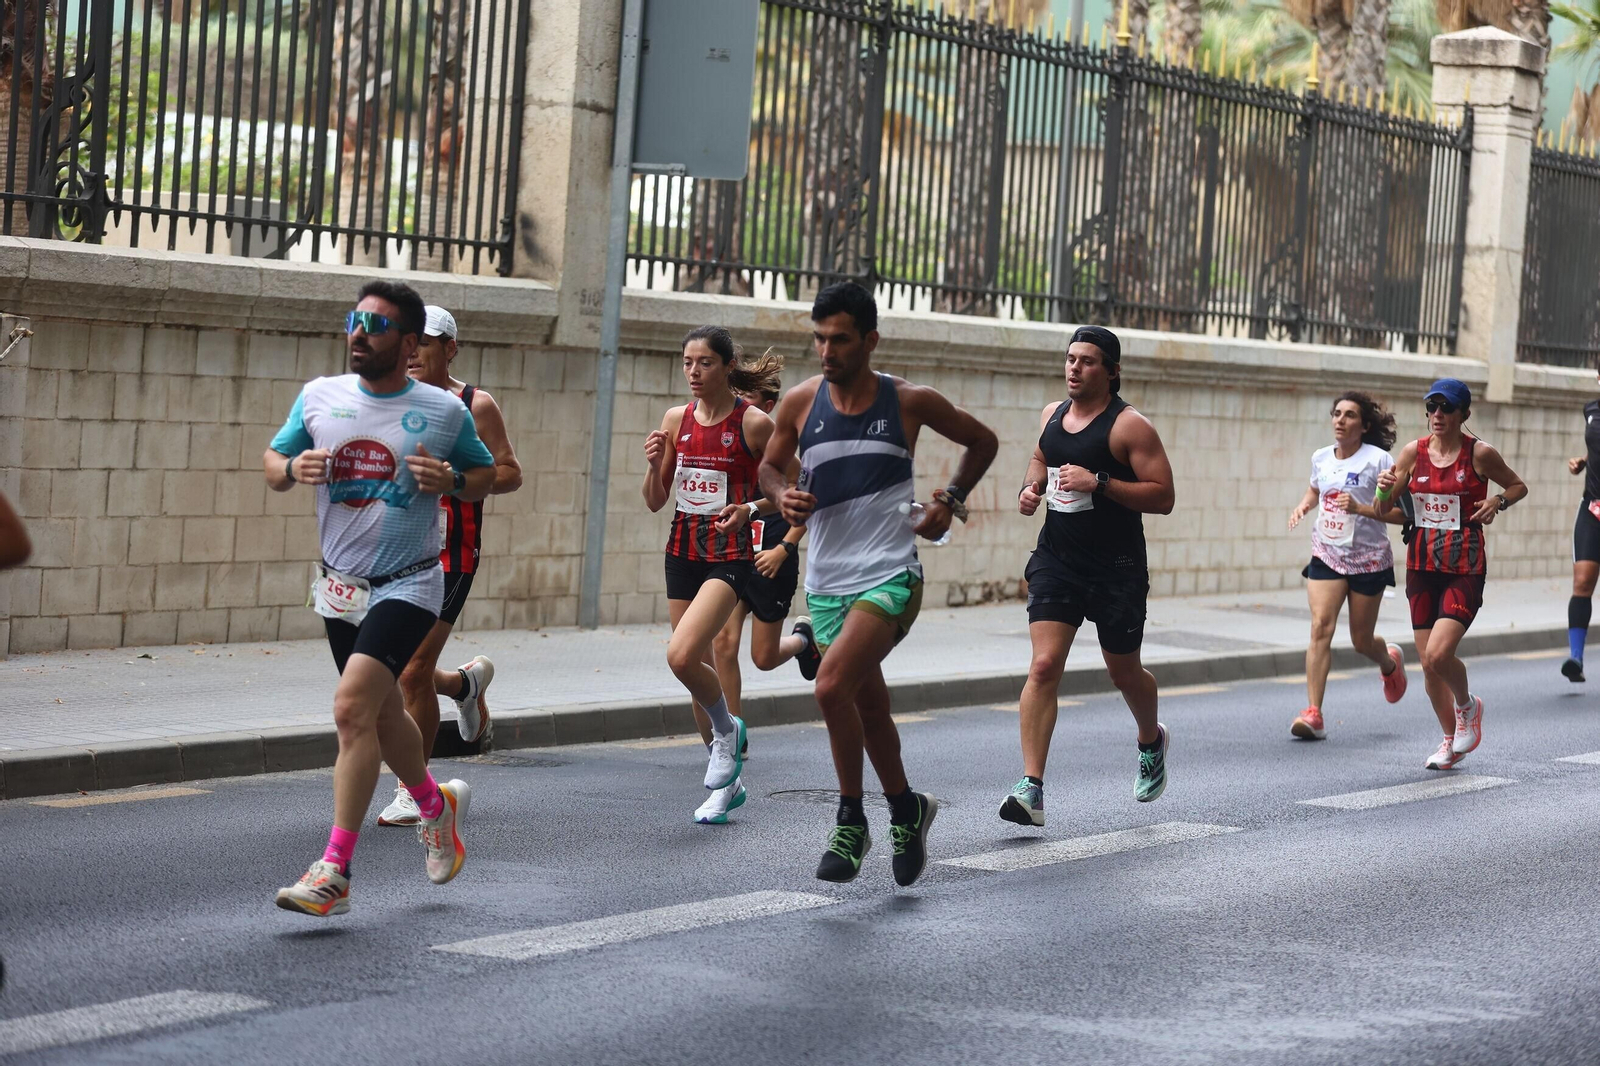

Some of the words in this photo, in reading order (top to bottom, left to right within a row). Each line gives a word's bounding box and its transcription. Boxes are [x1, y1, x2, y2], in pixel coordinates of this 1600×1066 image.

[343, 447, 366, 459] Café
[369, 450, 388, 461] Bar
[334, 458, 351, 468] Los
[354, 460, 393, 472] Rombos
[682, 480, 719, 493] 1345
[1425, 502, 1449, 513] 649
[1324, 520, 1344, 531] 397
[327, 577, 356, 601] 767
